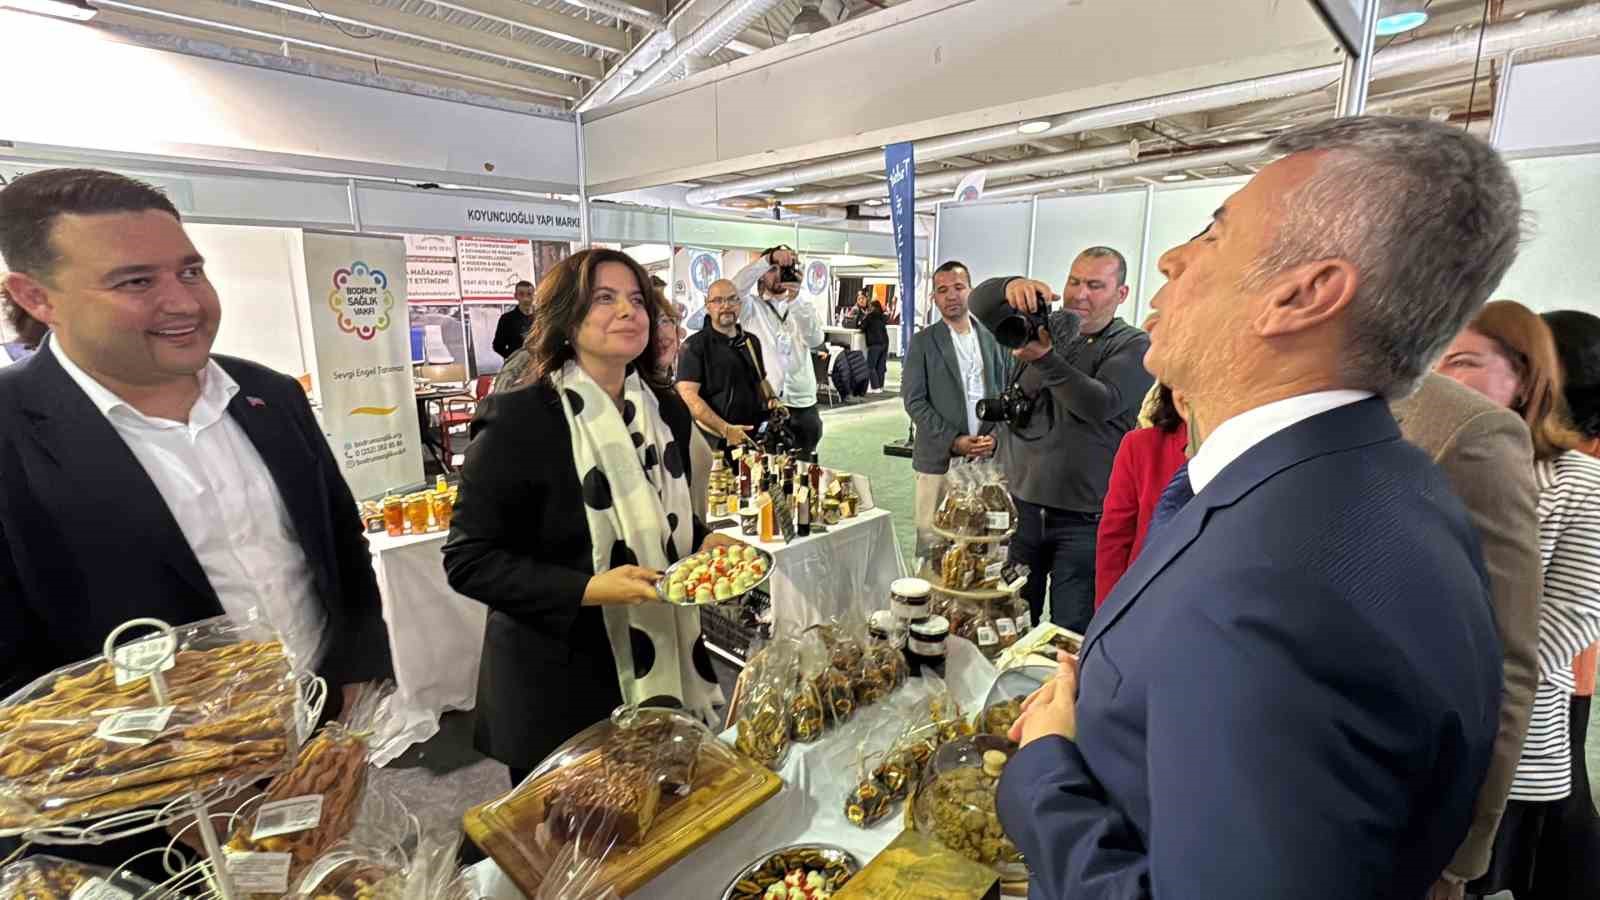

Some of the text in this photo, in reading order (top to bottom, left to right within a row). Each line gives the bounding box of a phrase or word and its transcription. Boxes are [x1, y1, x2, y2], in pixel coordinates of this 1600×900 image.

[467, 209, 534, 225] KOYUNCUOĞLU
[536, 214, 553, 226] YAPI
[347, 287, 377, 295] BODRUM
[347, 295, 378, 306] SAĞLIK
[353, 307, 375, 315] VAKFI
